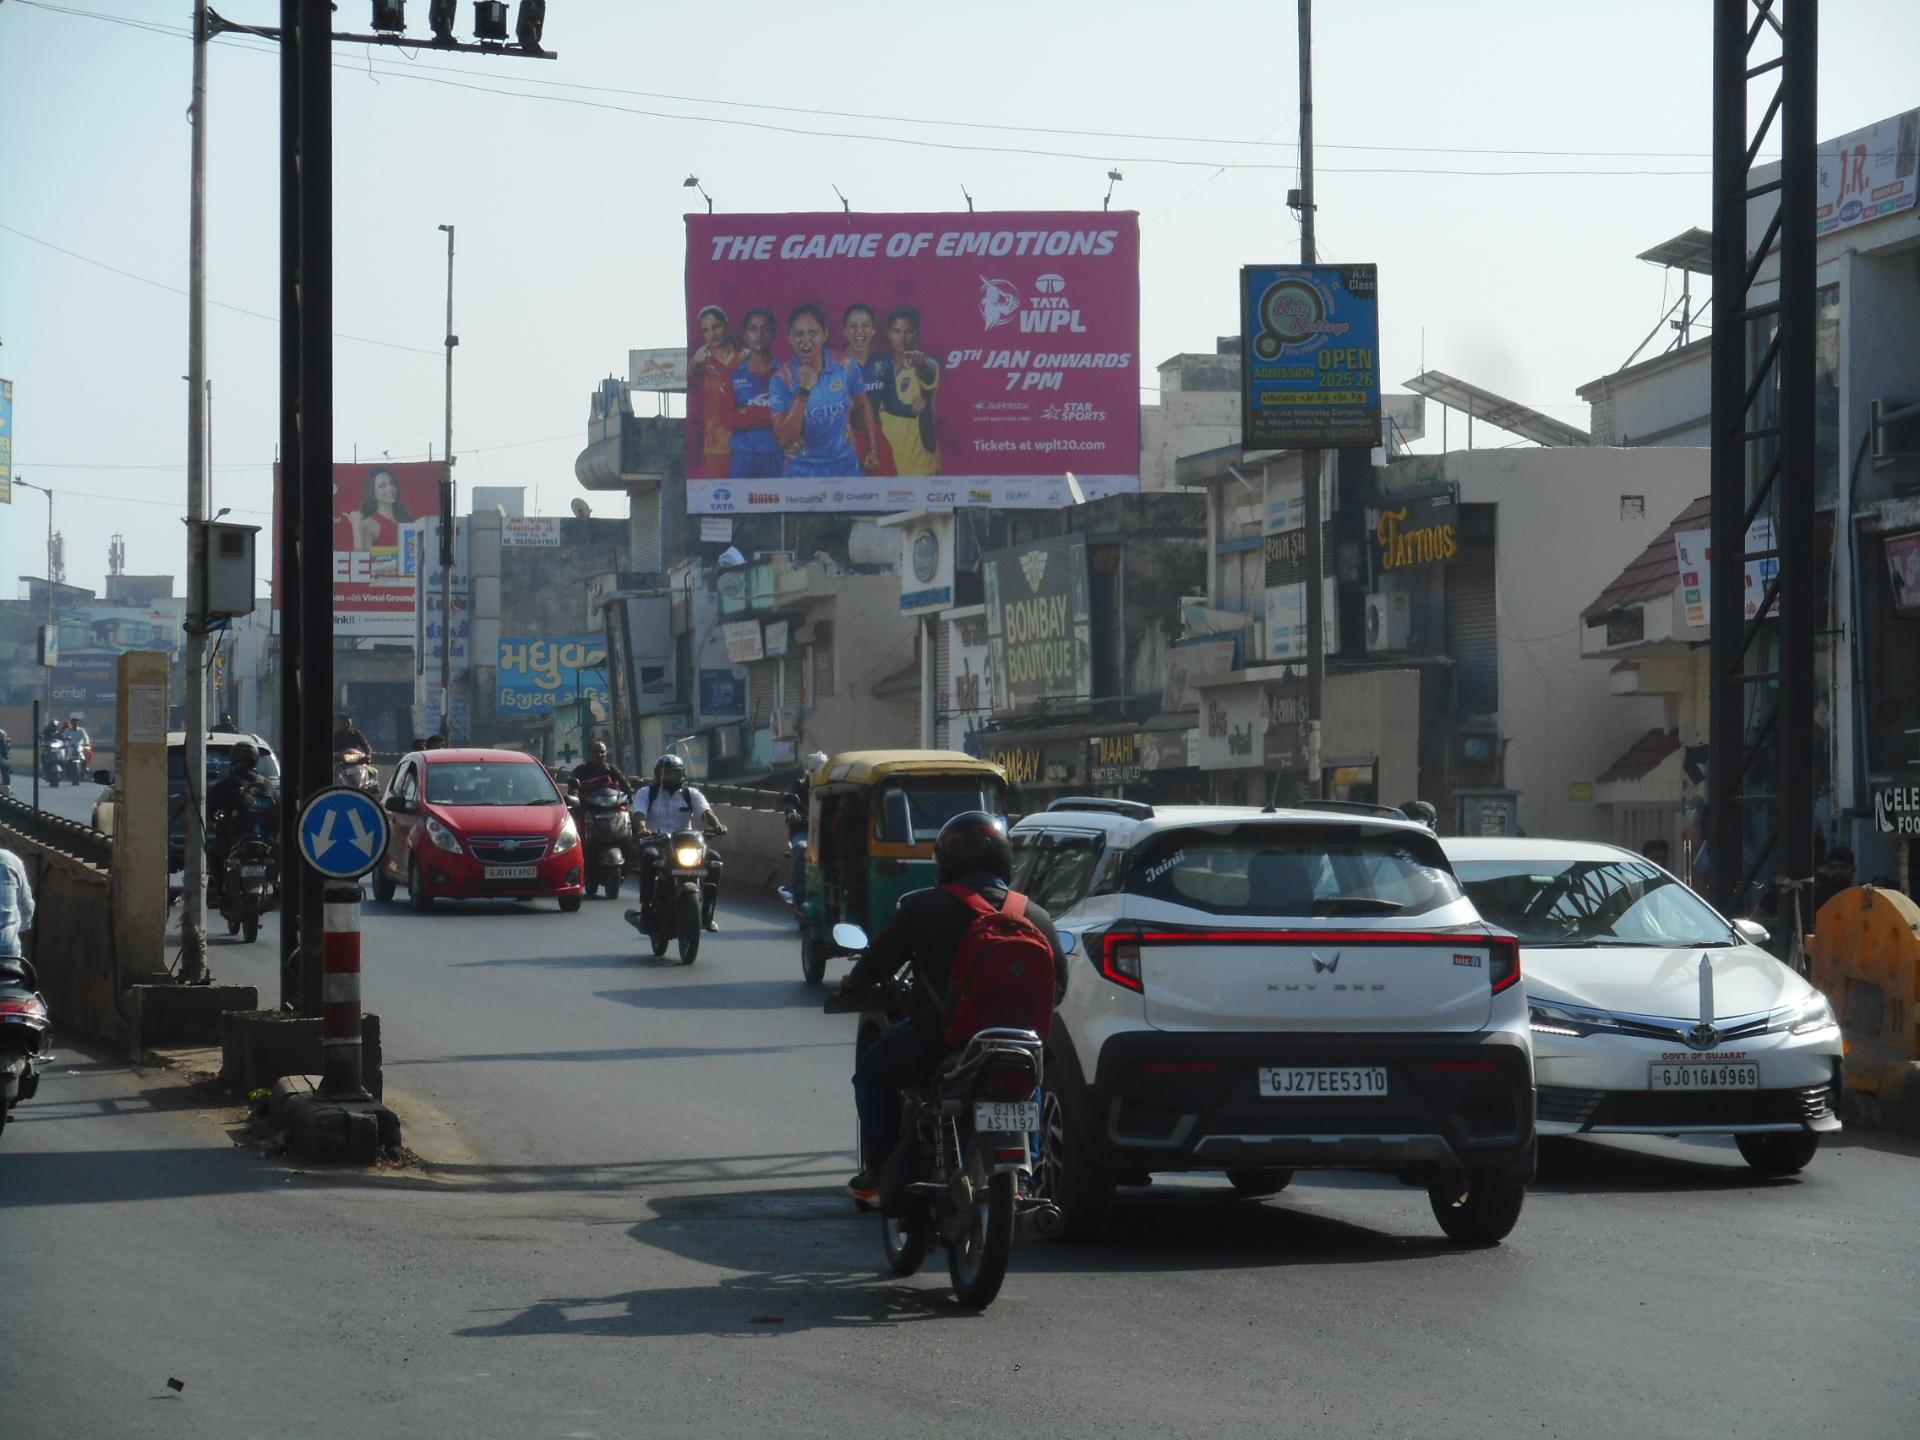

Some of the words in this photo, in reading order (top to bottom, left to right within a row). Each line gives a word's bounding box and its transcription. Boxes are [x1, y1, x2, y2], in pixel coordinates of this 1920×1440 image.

[711, 235, 777, 261] THE
[780, 233, 882, 260] GAME
[885, 232, 934, 258] OF
[935, 230, 1119, 257] EMOTIONS
[1349, 280, 1375, 290] Class
[1030, 297, 1070, 309] TATA
[1020, 309, 1087, 333] WPL
[945, 349, 983, 369] 9TH
[983, 350, 1031, 369] JAN
[1033, 353, 1132, 369] ONWARDS
[1318, 349, 1373, 370] OPEN
[1254, 367, 1315, 378] ADMISSION
[1319, 372, 1374, 387] 2025-26
[1005, 372, 1021, 390] 7
[1021, 372, 1063, 390] PM
[1063, 402, 1093, 412] STAR
[1061, 411, 1106, 422] SPORTS
[974, 440, 1017, 451] Tickets
[1019, 441, 1032, 451] at
[1034, 440, 1105, 453] wplt20.com
[846, 492, 879, 500] ChatGPT
[926, 492, 956, 503] CEAT
[710, 503, 734, 511] TATA
[1005, 594, 1067, 644] BOMBAY
[1007, 640, 1072, 686] BOUTIQUE
[1099, 736, 1135, 763] MAAHI
[1884, 787, 1920, 812] CELE
[1898, 816, 1920, 834] FOO
[1266, 983, 1317, 991] XUV
[1662, 1052, 1688, 1061] GOVT.
[1691, 1052, 1702, 1060] OF
[1705, 1052, 1746, 1060] GUJARAT
[1271, 1072, 1385, 1091] GJ27EE5310
[1663, 1069, 1755, 1086] GJ01GA9969
[994, 1104, 1026, 1117] GJ18
[987, 1117, 1034, 1130] AS1197
